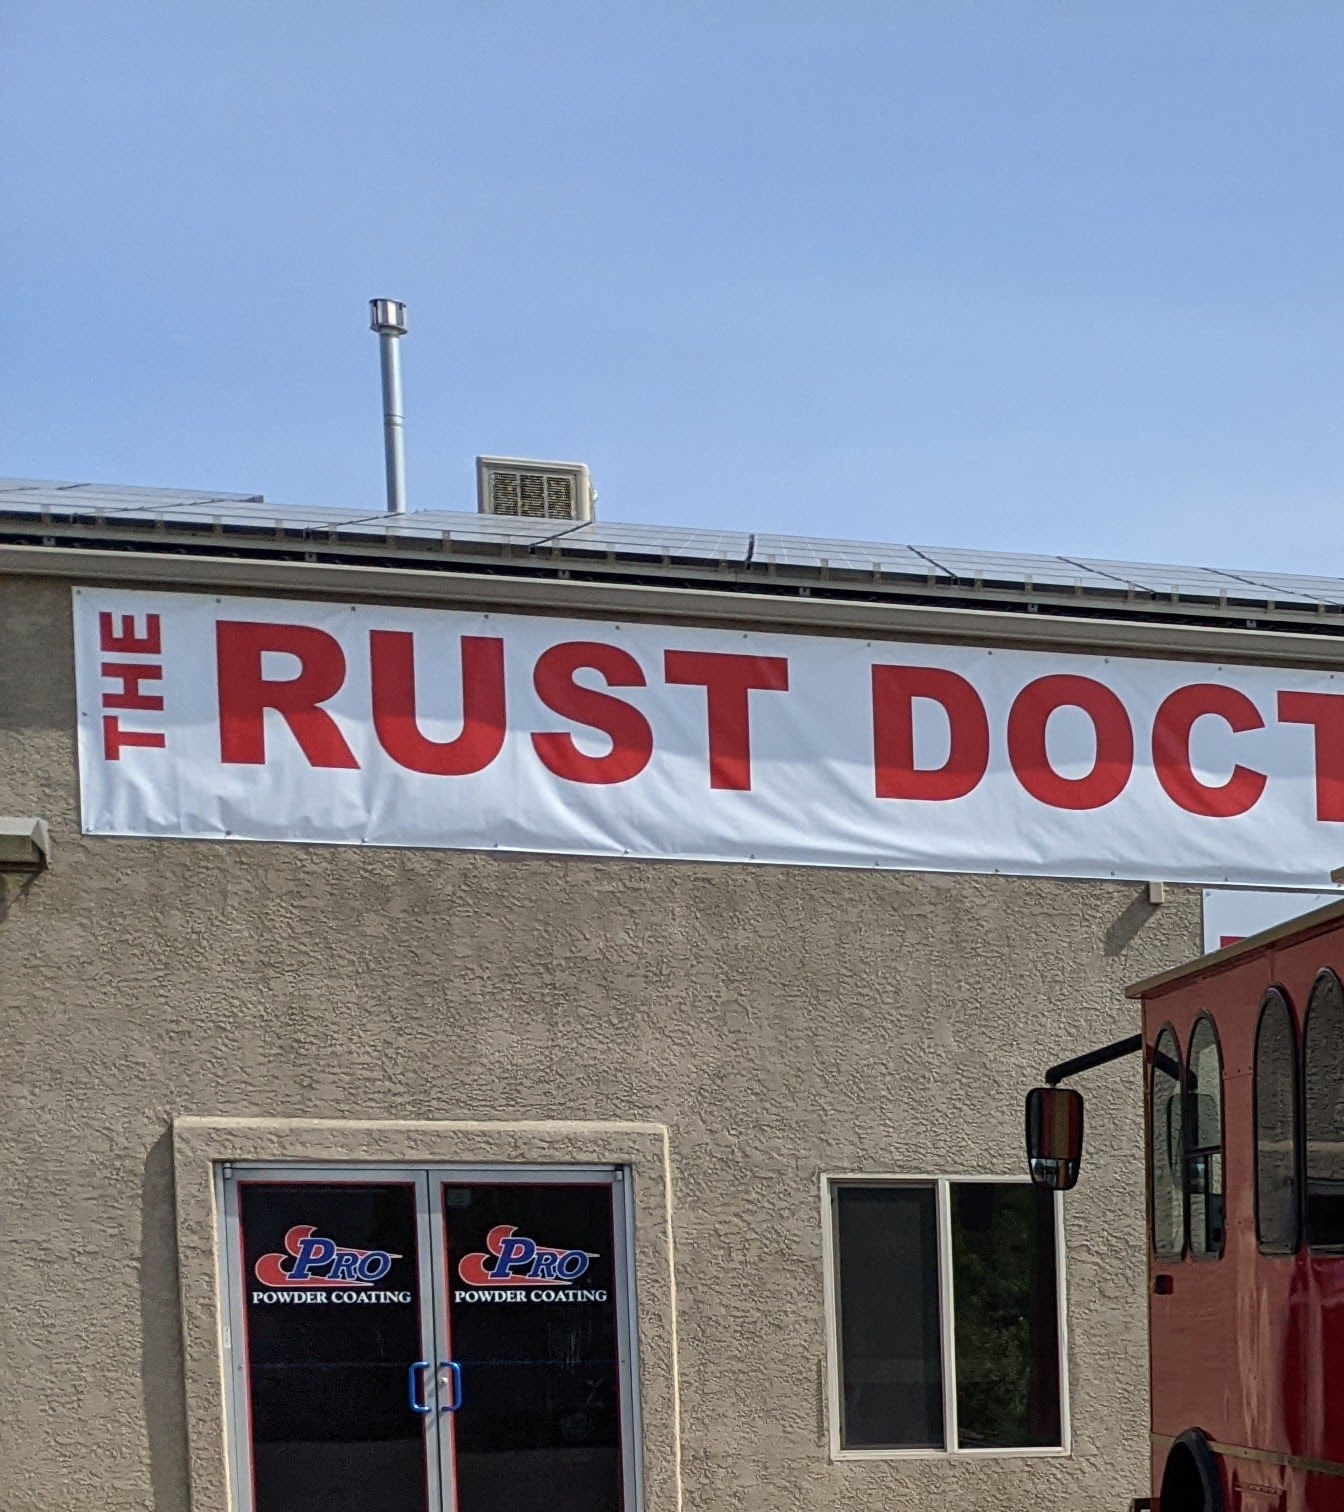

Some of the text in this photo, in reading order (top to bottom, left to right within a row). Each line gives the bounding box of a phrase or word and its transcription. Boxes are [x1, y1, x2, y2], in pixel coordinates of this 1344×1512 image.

[99, 612, 167, 761] THE
[215, 619, 790, 791] RUST
[252, 1290, 411, 1304] POWDER COATING
[454, 1289, 608, 1303] POWDER COATING
